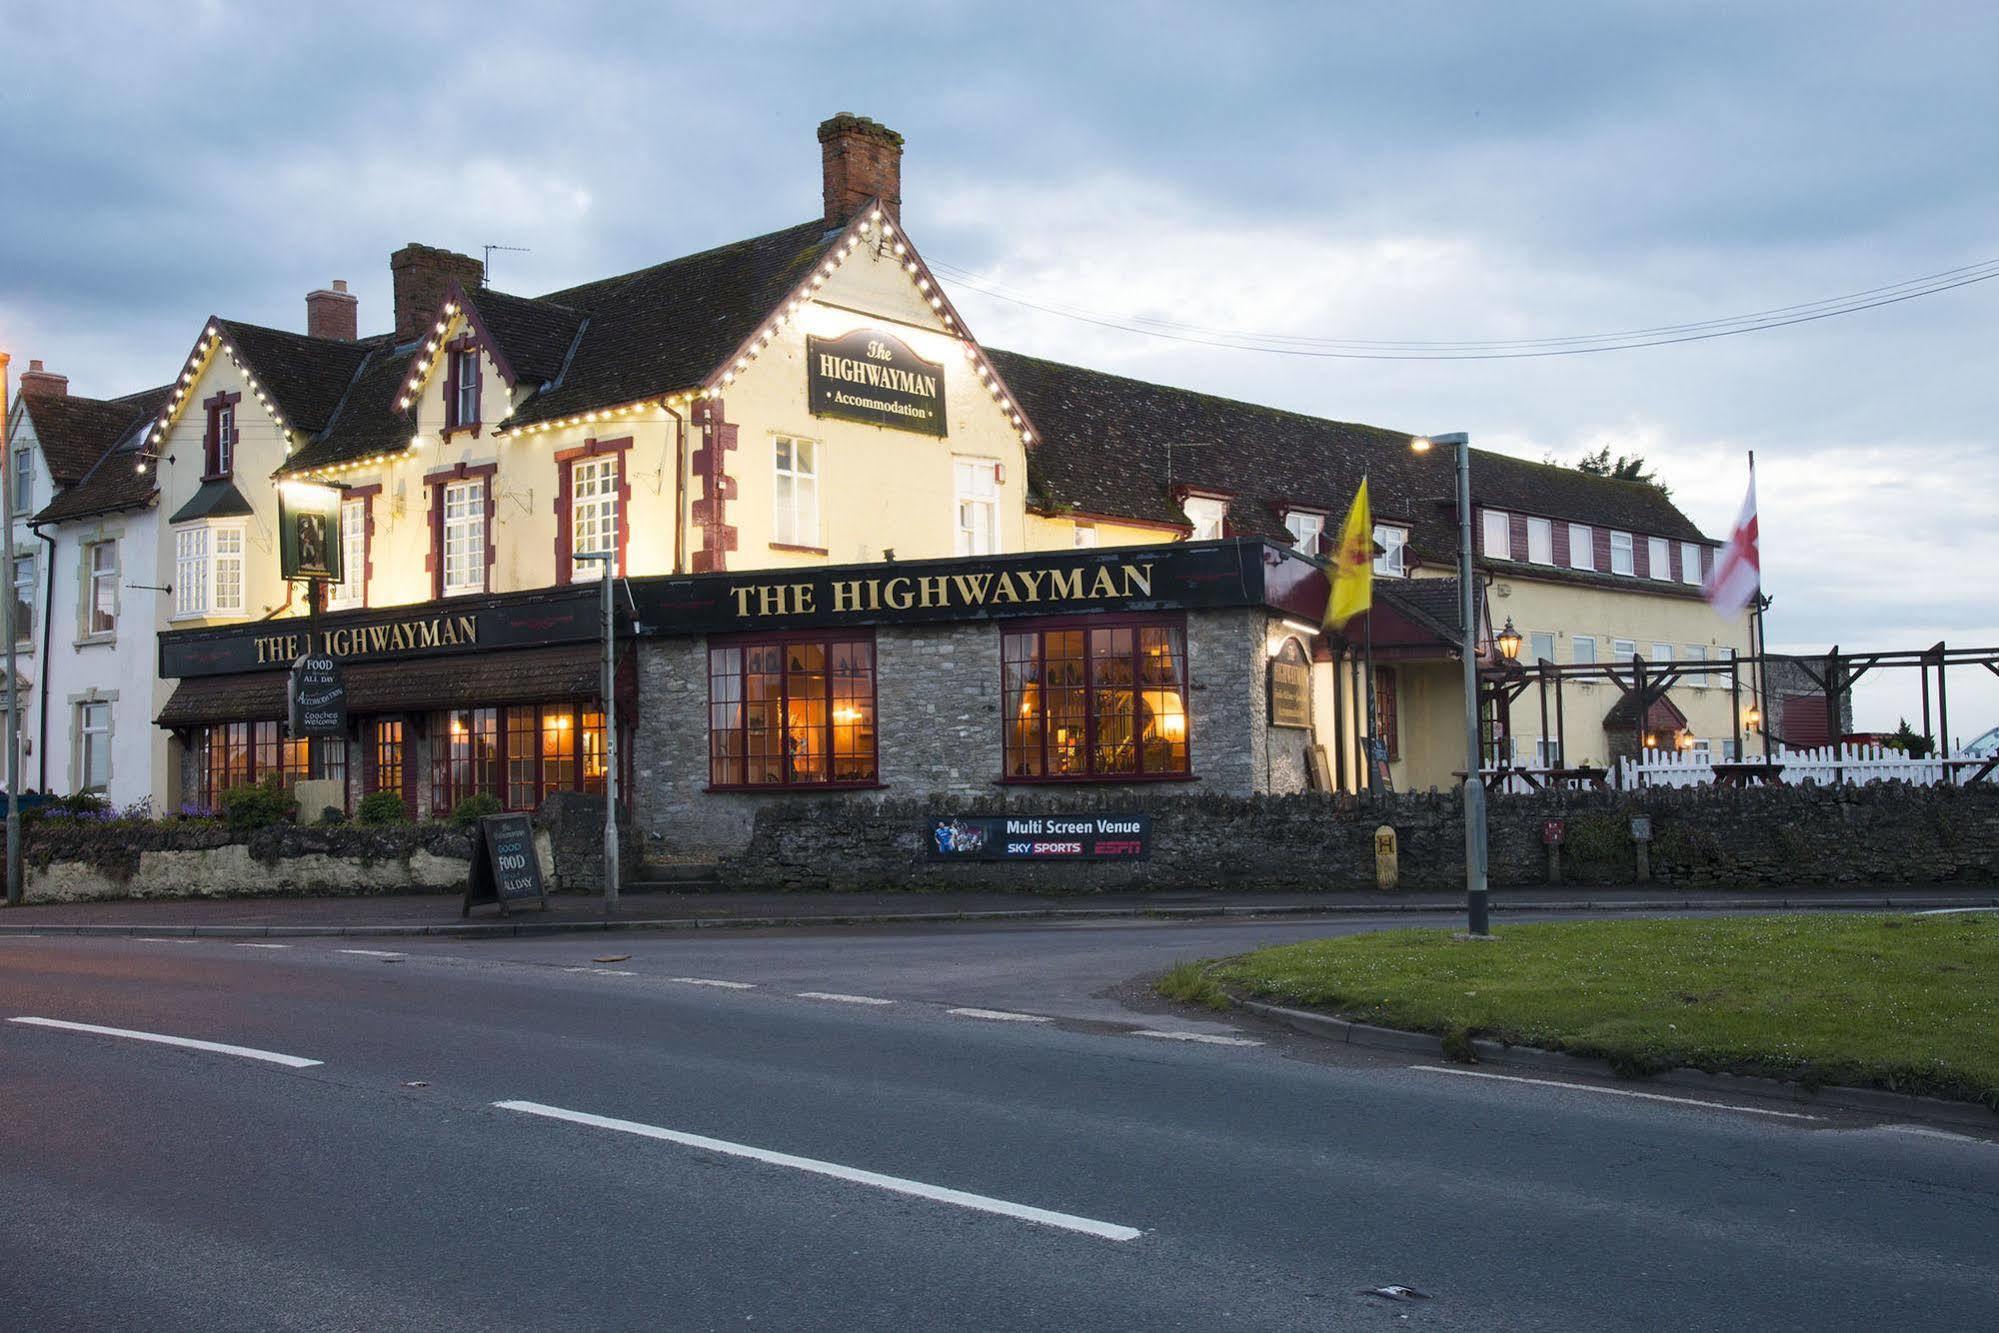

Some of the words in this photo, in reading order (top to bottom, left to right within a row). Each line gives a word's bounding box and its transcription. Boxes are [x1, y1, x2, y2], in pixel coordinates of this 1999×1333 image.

[866, 340, 893, 361] The
[819, 353, 937, 399] HIGHWAYMAN
[834, 390, 927, 419] Accommodation
[730, 583, 816, 617] THE
[832, 564, 1153, 612] HIGHWAYMAN
[254, 634, 300, 664] THE
[306, 659, 334, 671] FOOD
[1006, 820, 1042, 834] Multi
[1046, 820, 1092, 834] Screen
[1097, 819, 1140, 834] Venue
[1007, 843, 1031, 853] SKY
[1034, 842, 1081, 853] SPORTS
[1095, 841, 1141, 854] ESPN
[498, 854, 526, 871] FOOD
